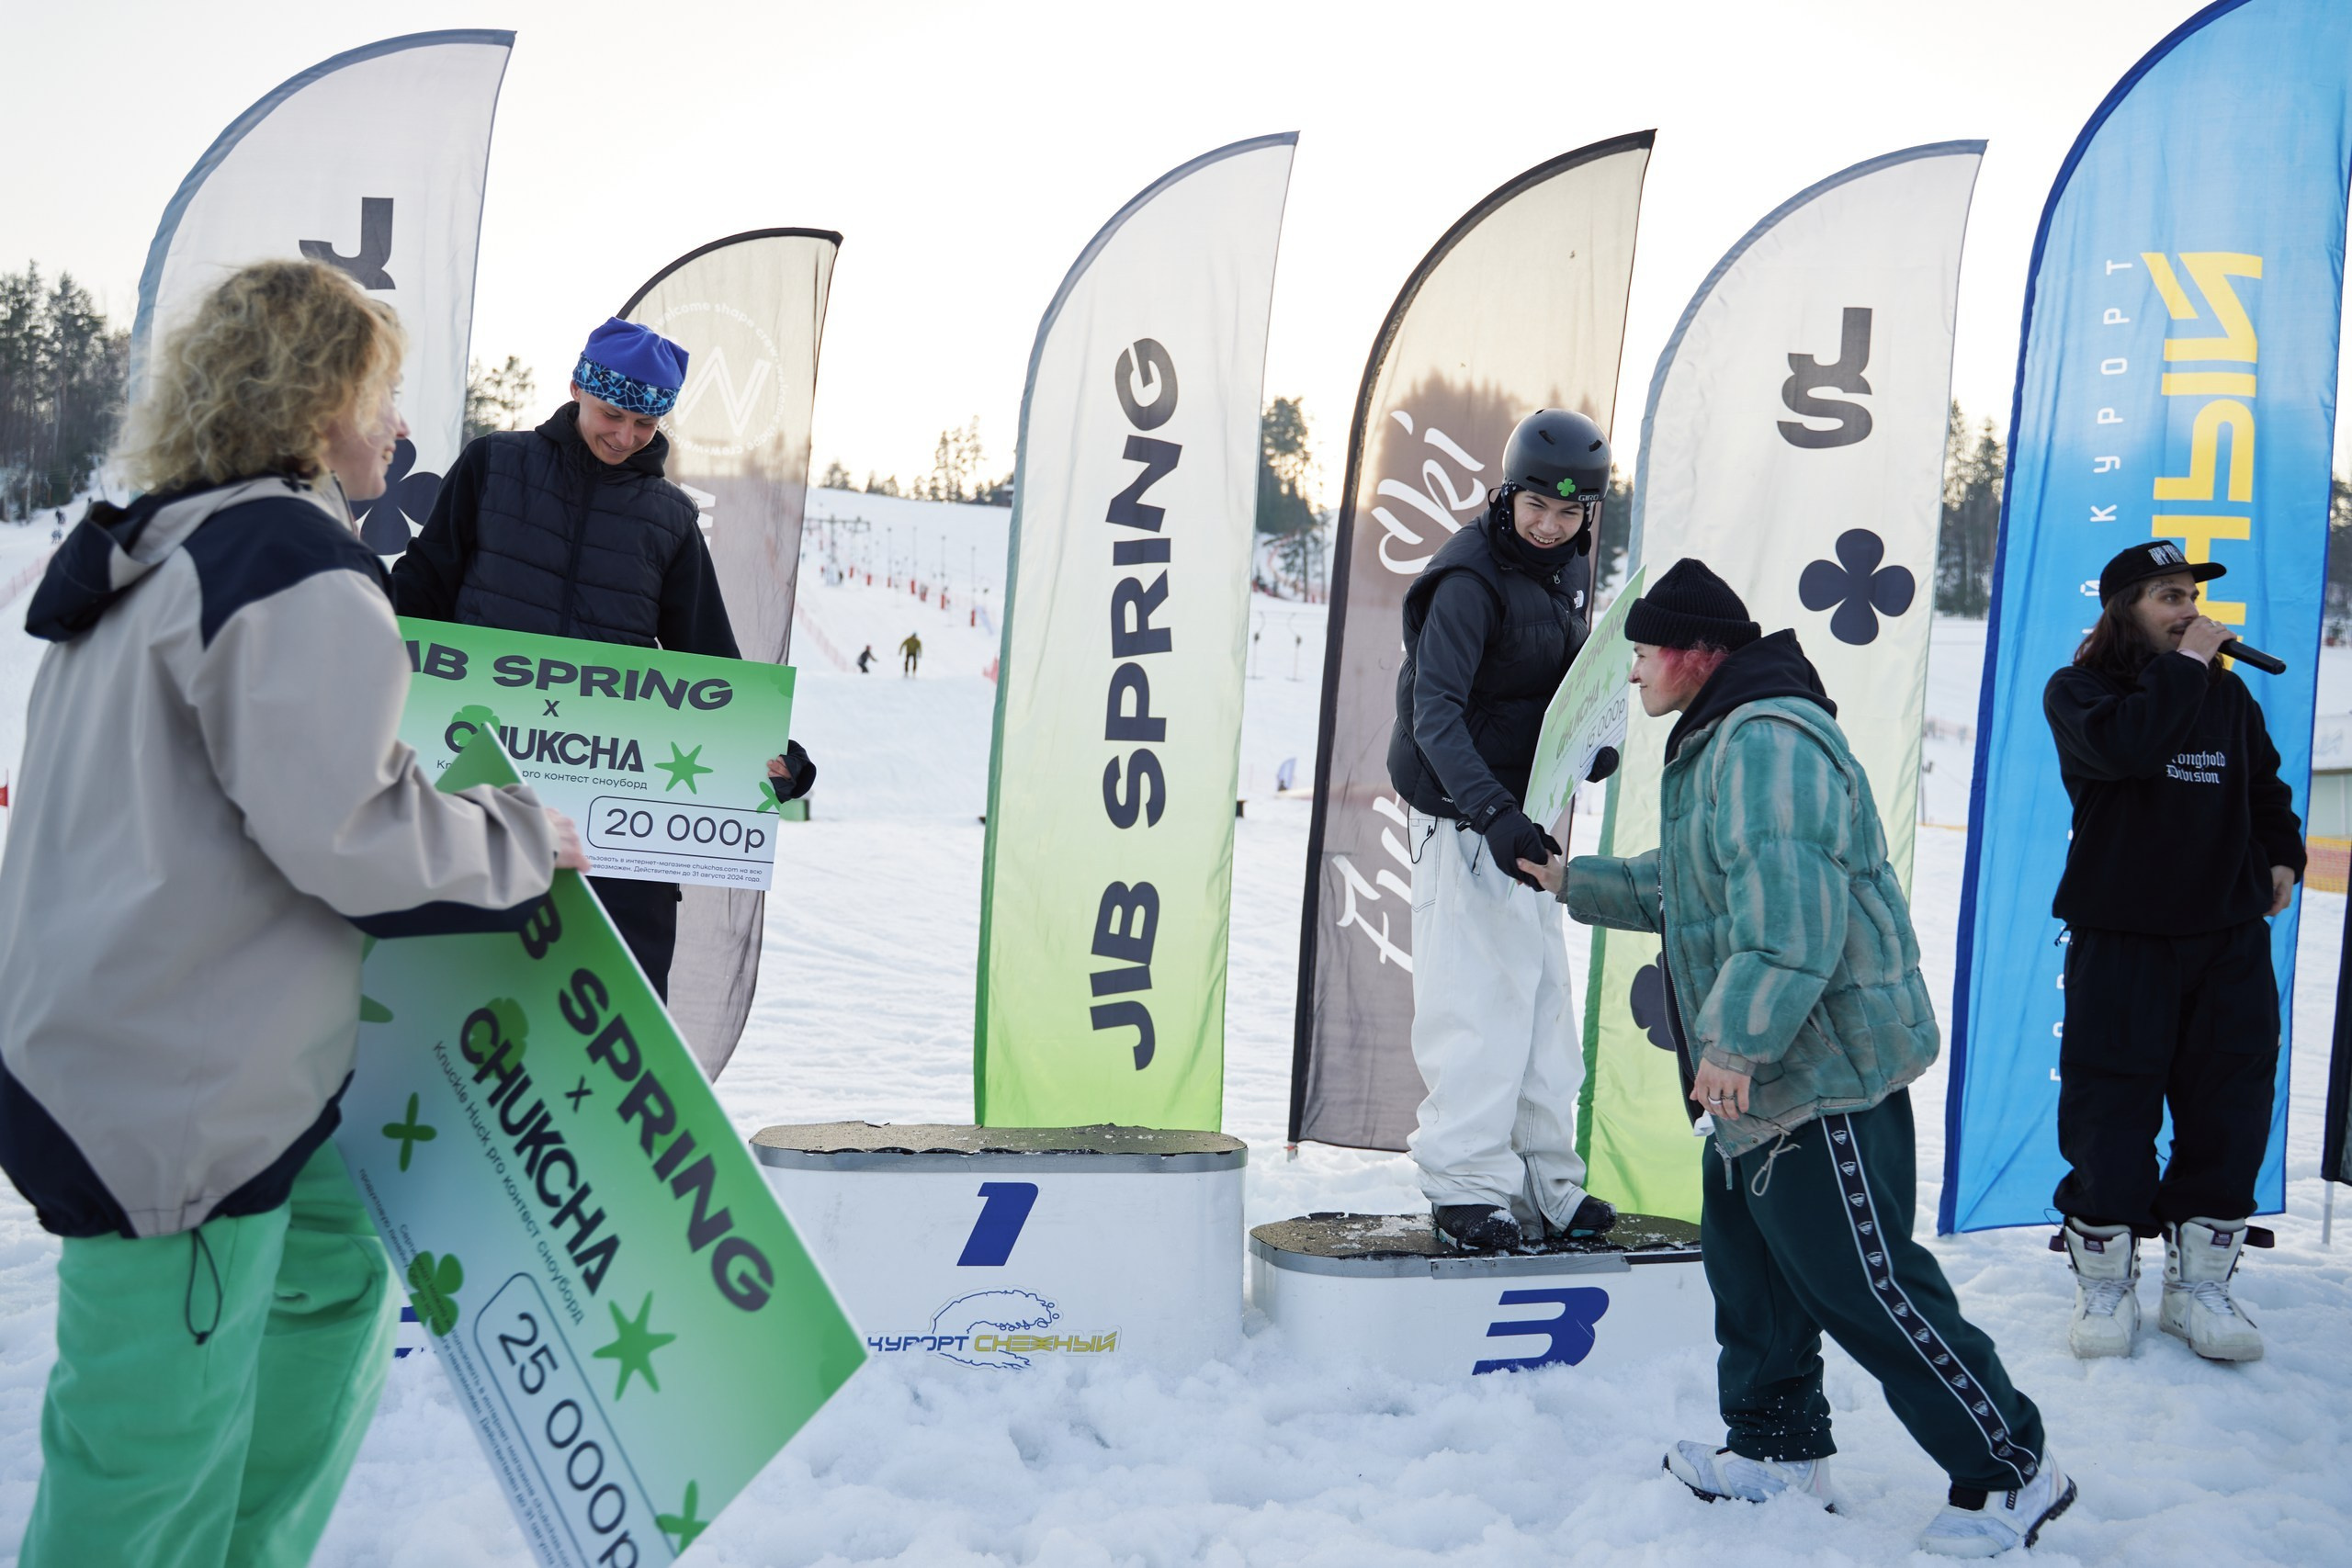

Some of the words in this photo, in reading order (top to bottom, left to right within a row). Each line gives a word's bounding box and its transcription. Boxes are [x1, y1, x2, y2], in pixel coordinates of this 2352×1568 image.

[1102, 338, 1183, 829] SPRING
[405, 640, 469, 681] IB
[492, 655, 733, 711] SPRING
[544, 772, 590, 784] контест
[592, 776, 648, 791] сноуборд
[2165, 764, 2221, 784] Division
[605, 808, 654, 839] 20
[626, 858, 691, 869] интернет-магазине
[692, 863, 738, 873] chukchas.com
[1090, 880, 1160, 1071] JIB
[460, 1008, 622, 1295] CHUKCHA
[558, 967, 775, 1312] SPRING
[433, 1040, 469, 1104] Knuckle
[465, 1101, 492, 1145] Huck
[485, 1146, 505, 1176] pro
[503, 1175, 542, 1238] контест
[537, 1240, 585, 1326] сноуборд
[956, 1182, 1038, 1267] 1
[497, 1312, 558, 1395] 25
[973, 1330, 1118, 1352] СНЕЖНЫЙ
[1472, 1287, 1610, 1376] 3
